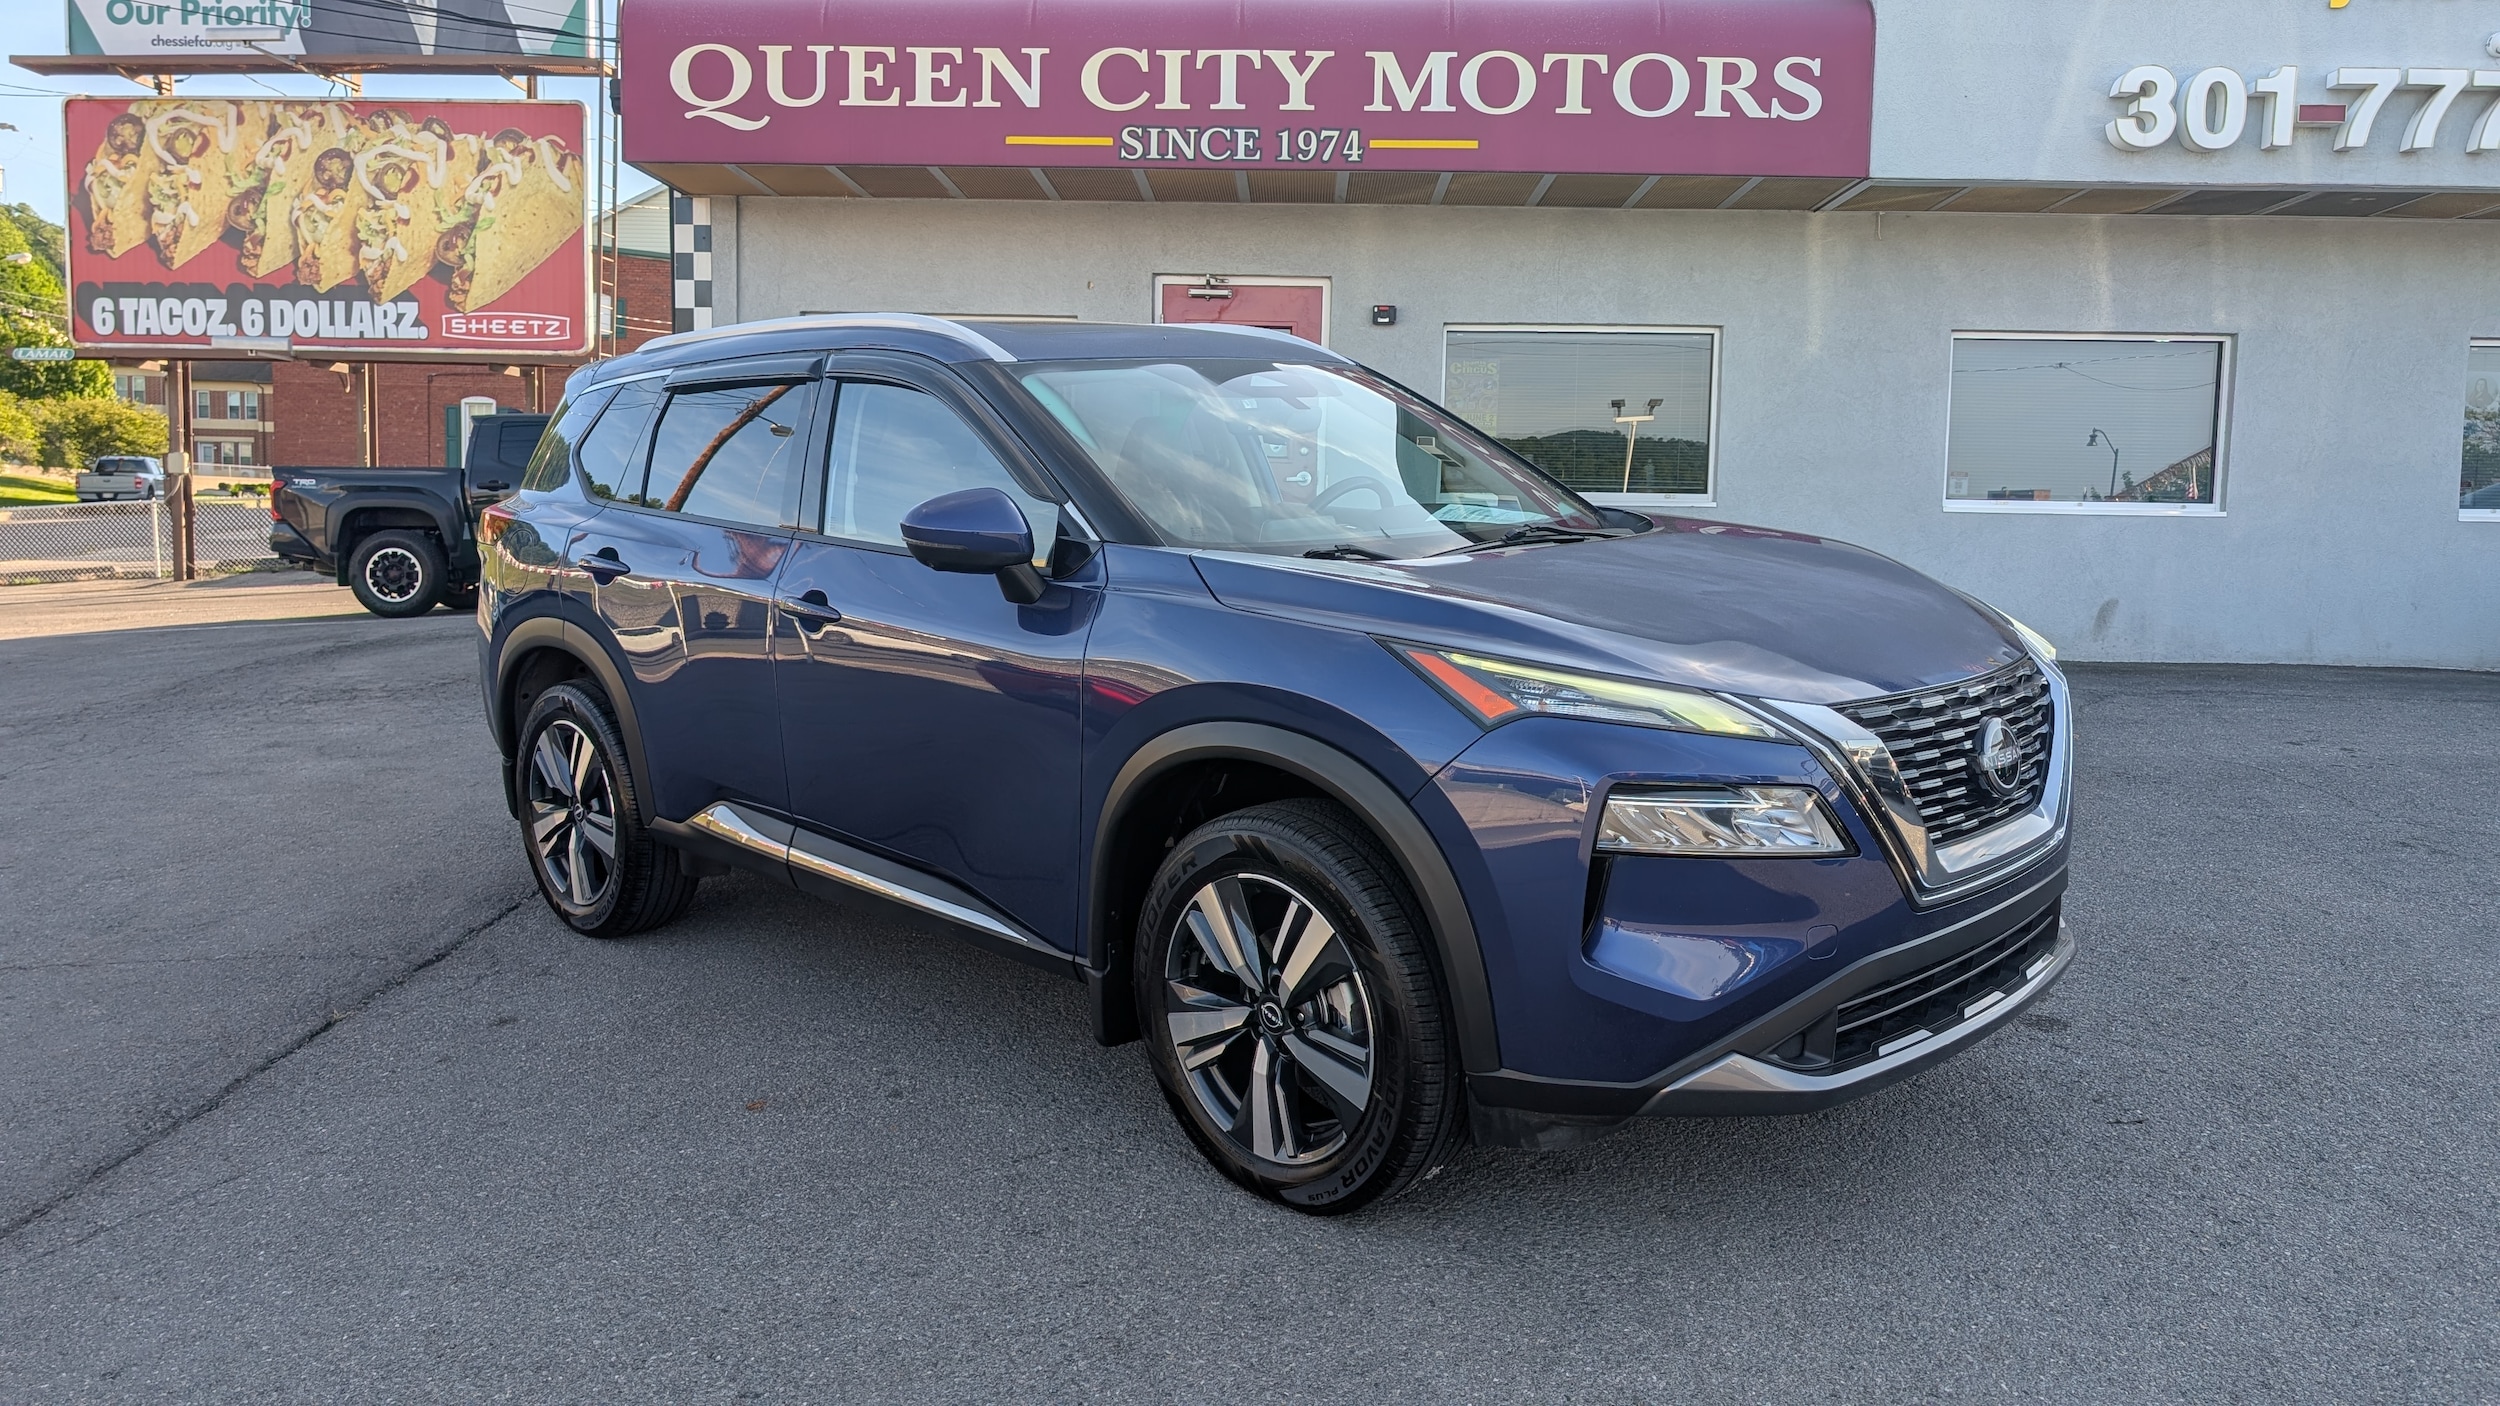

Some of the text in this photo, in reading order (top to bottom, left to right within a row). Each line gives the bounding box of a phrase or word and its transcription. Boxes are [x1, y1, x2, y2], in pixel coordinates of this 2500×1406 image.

[106, 0, 312, 35] Our Priority!
[669, 43, 1823, 131] QUEEN CITY MOTORS
[1119, 126, 1364, 163] SINCE 1974
[92, 297, 429, 340] 6 TACOZ. 6 DOLLARZ.
[451, 318, 561, 336] SHEETZ
[18, 350, 69, 359] LAMAR
[1464, 413, 1495, 422] JUNE 2
[292, 478, 316, 486] TRD
[1139, 851, 1199, 980] COOPER
[1307, 1038, 1399, 1203] ENDEAVOR PLUS
